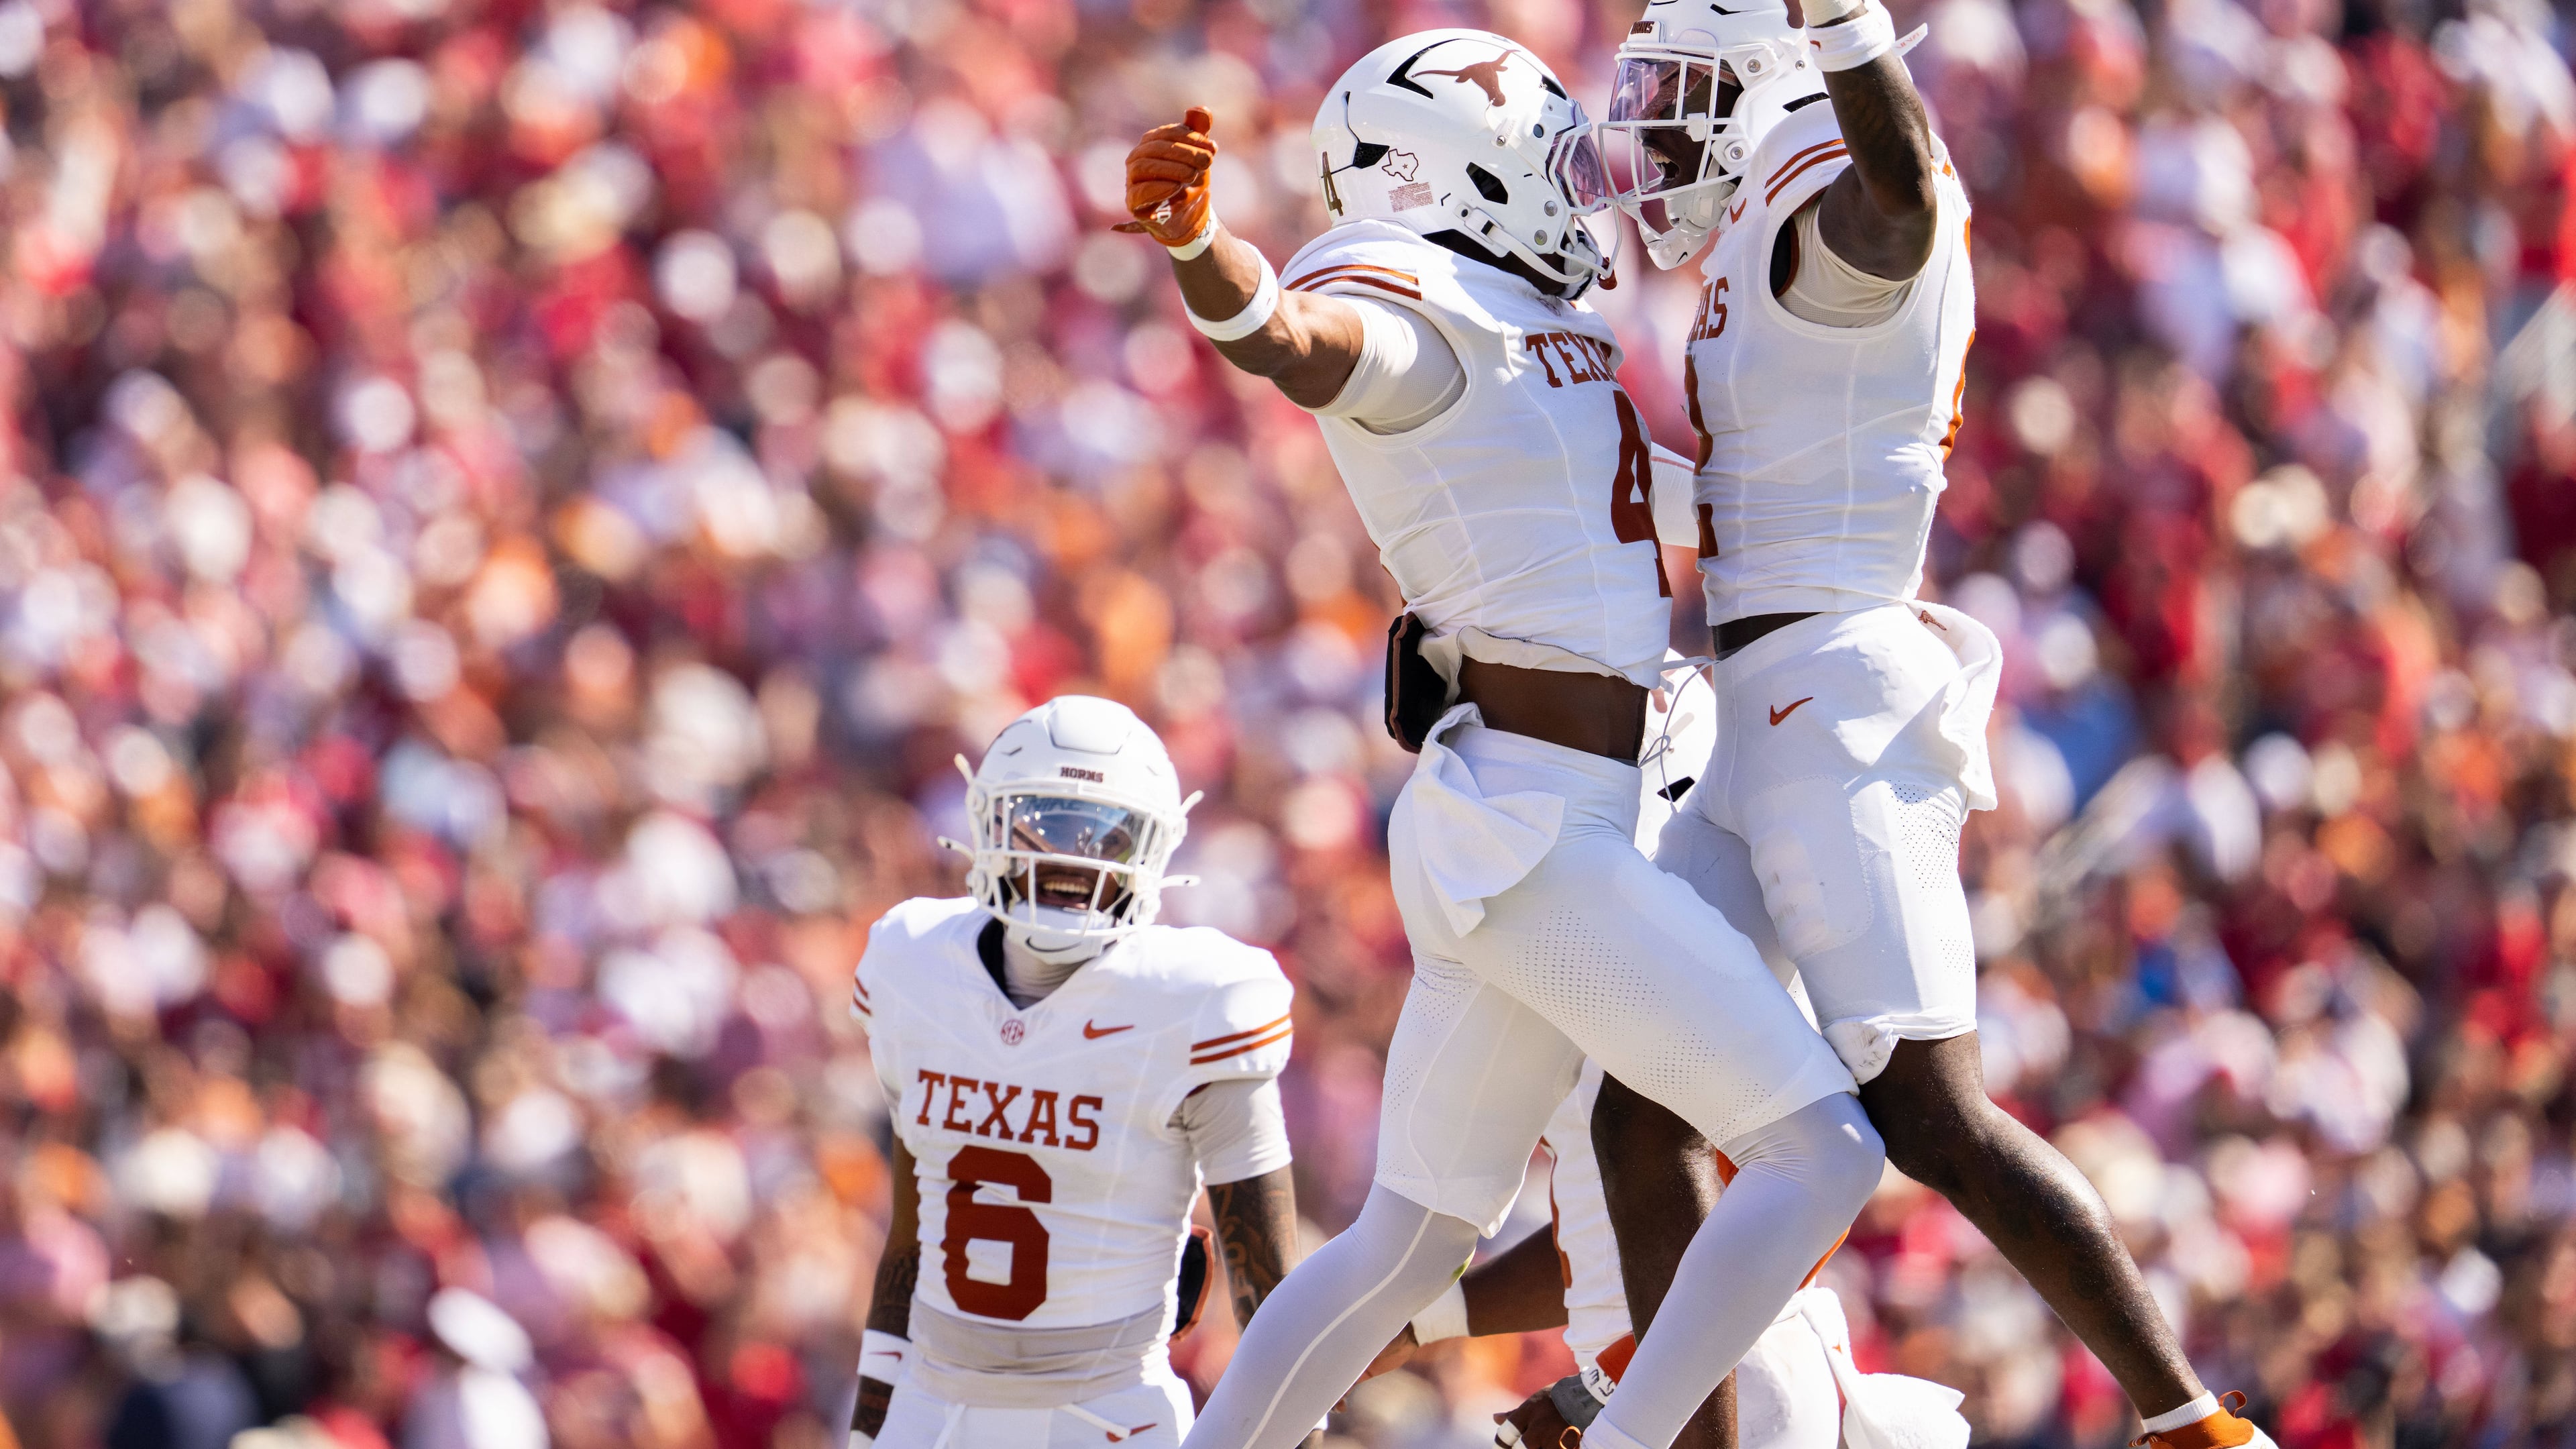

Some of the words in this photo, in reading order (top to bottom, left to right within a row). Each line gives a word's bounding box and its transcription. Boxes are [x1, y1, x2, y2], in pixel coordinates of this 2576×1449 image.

[1611, 390, 1674, 598] 4
[1061, 767, 1104, 783] HORNS
[916, 1069, 1102, 1151] TEXAS
[940, 1144, 1052, 1322] 6
